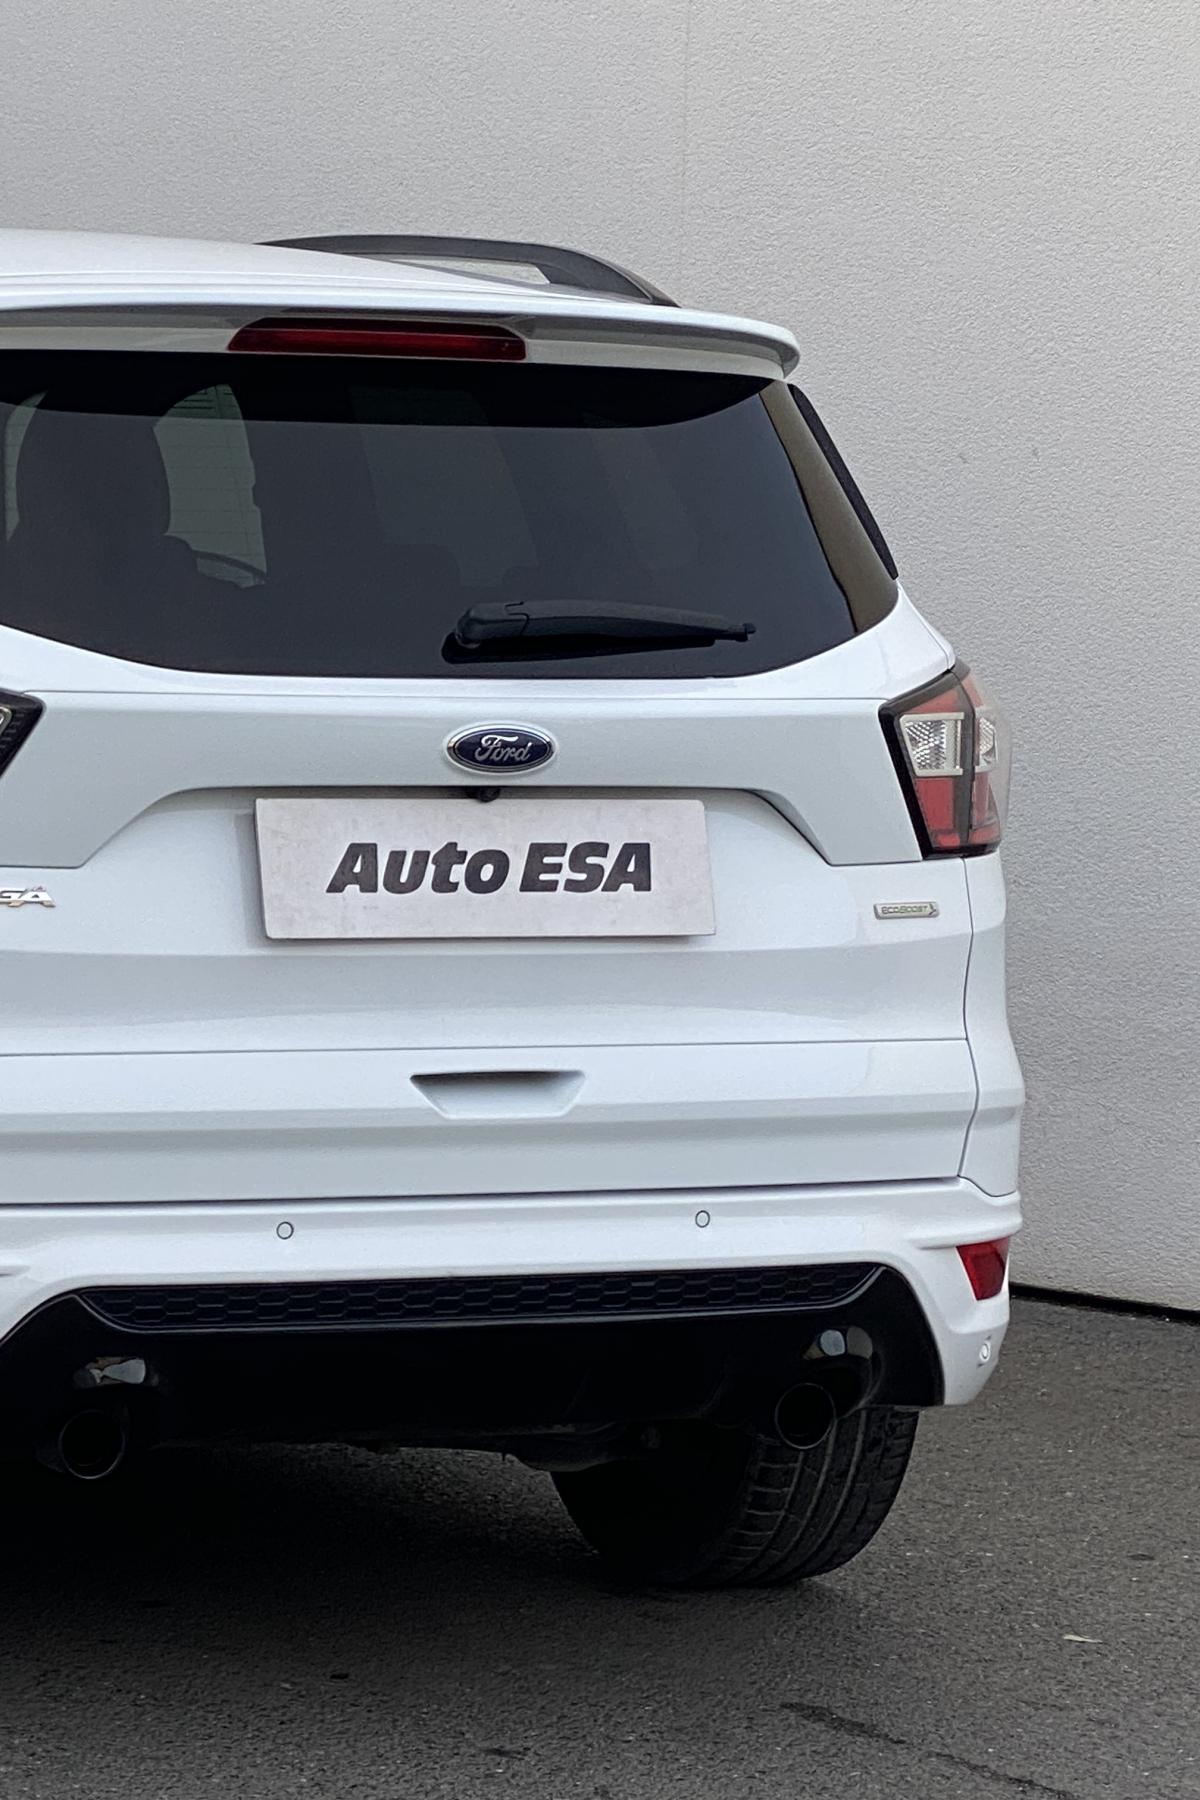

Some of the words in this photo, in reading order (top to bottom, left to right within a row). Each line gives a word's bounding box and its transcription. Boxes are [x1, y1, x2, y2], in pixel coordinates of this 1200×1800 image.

[474, 734, 533, 762] Ford
[325, 842, 510, 894] Auto
[519, 842, 652, 892] ESA
